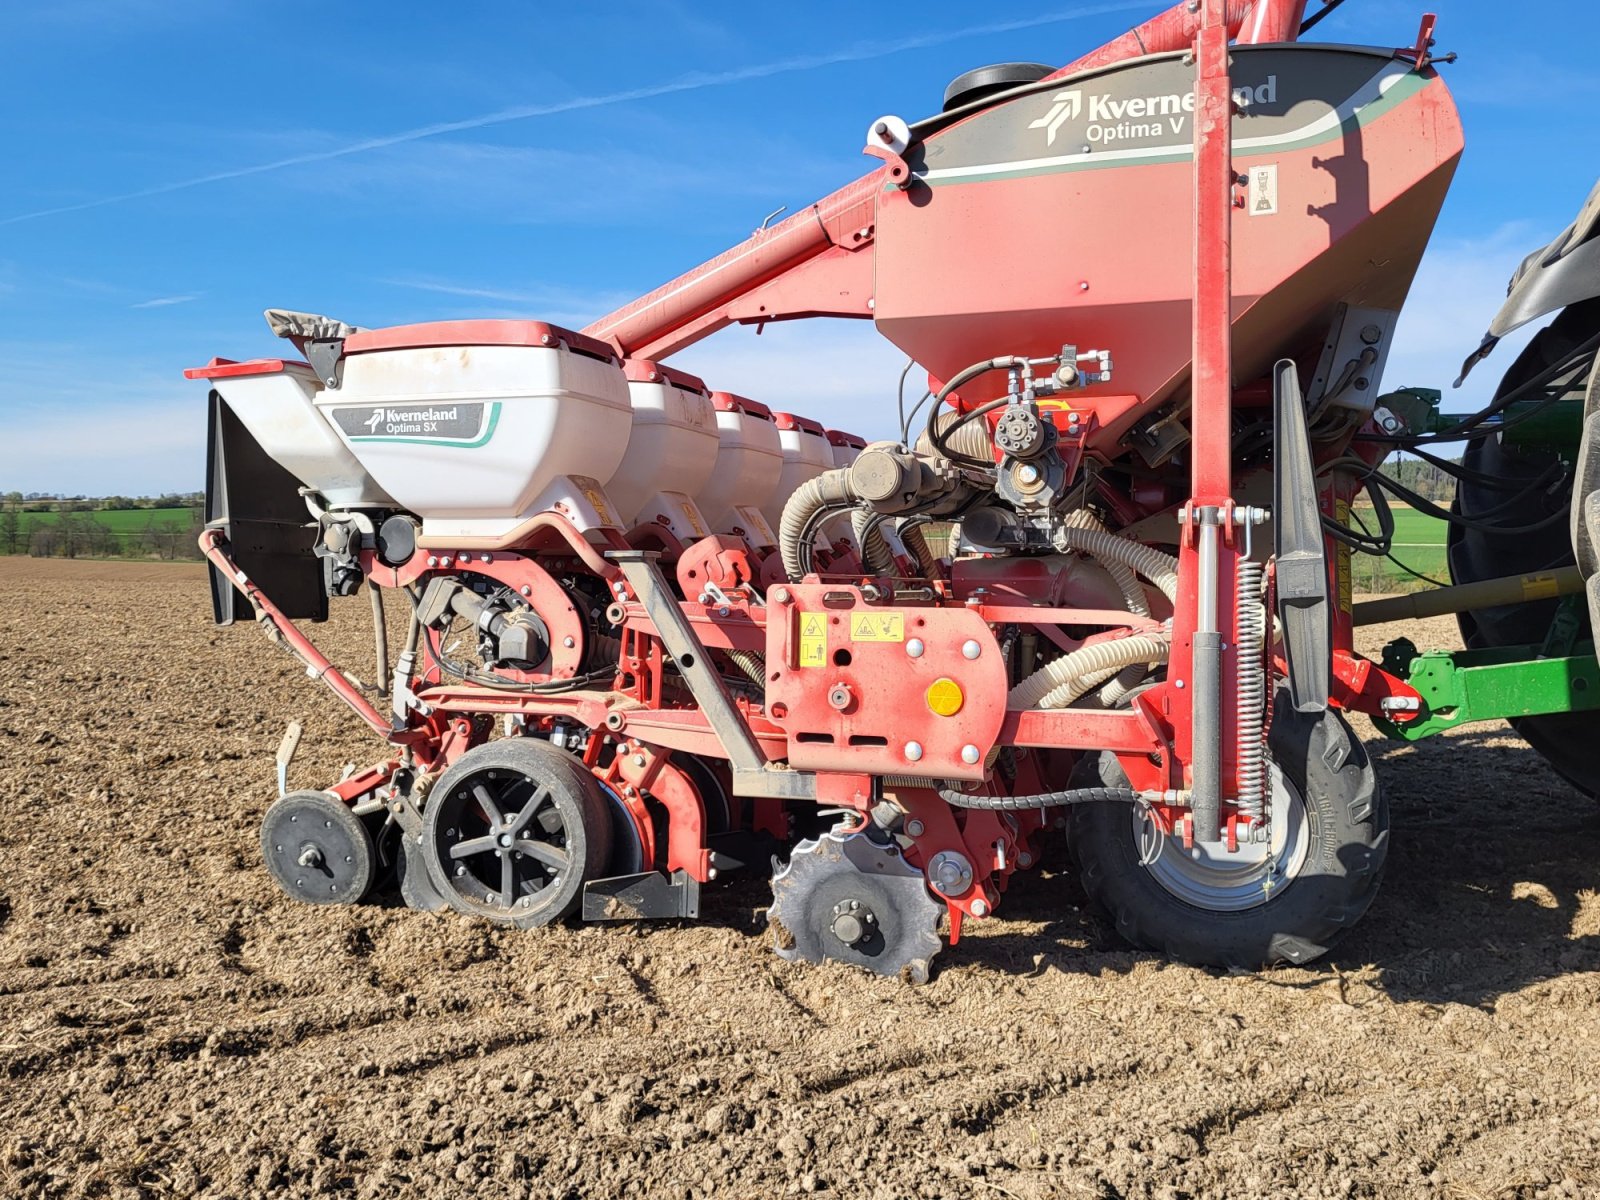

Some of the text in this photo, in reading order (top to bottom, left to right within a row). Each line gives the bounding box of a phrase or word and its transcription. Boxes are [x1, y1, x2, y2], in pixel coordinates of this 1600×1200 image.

[1088, 75, 1277, 122] Kvernend
[1086, 116, 1185, 144] Optima V
[386, 407, 457, 422] Kverneland
[386, 421, 438, 435] Optima SX
